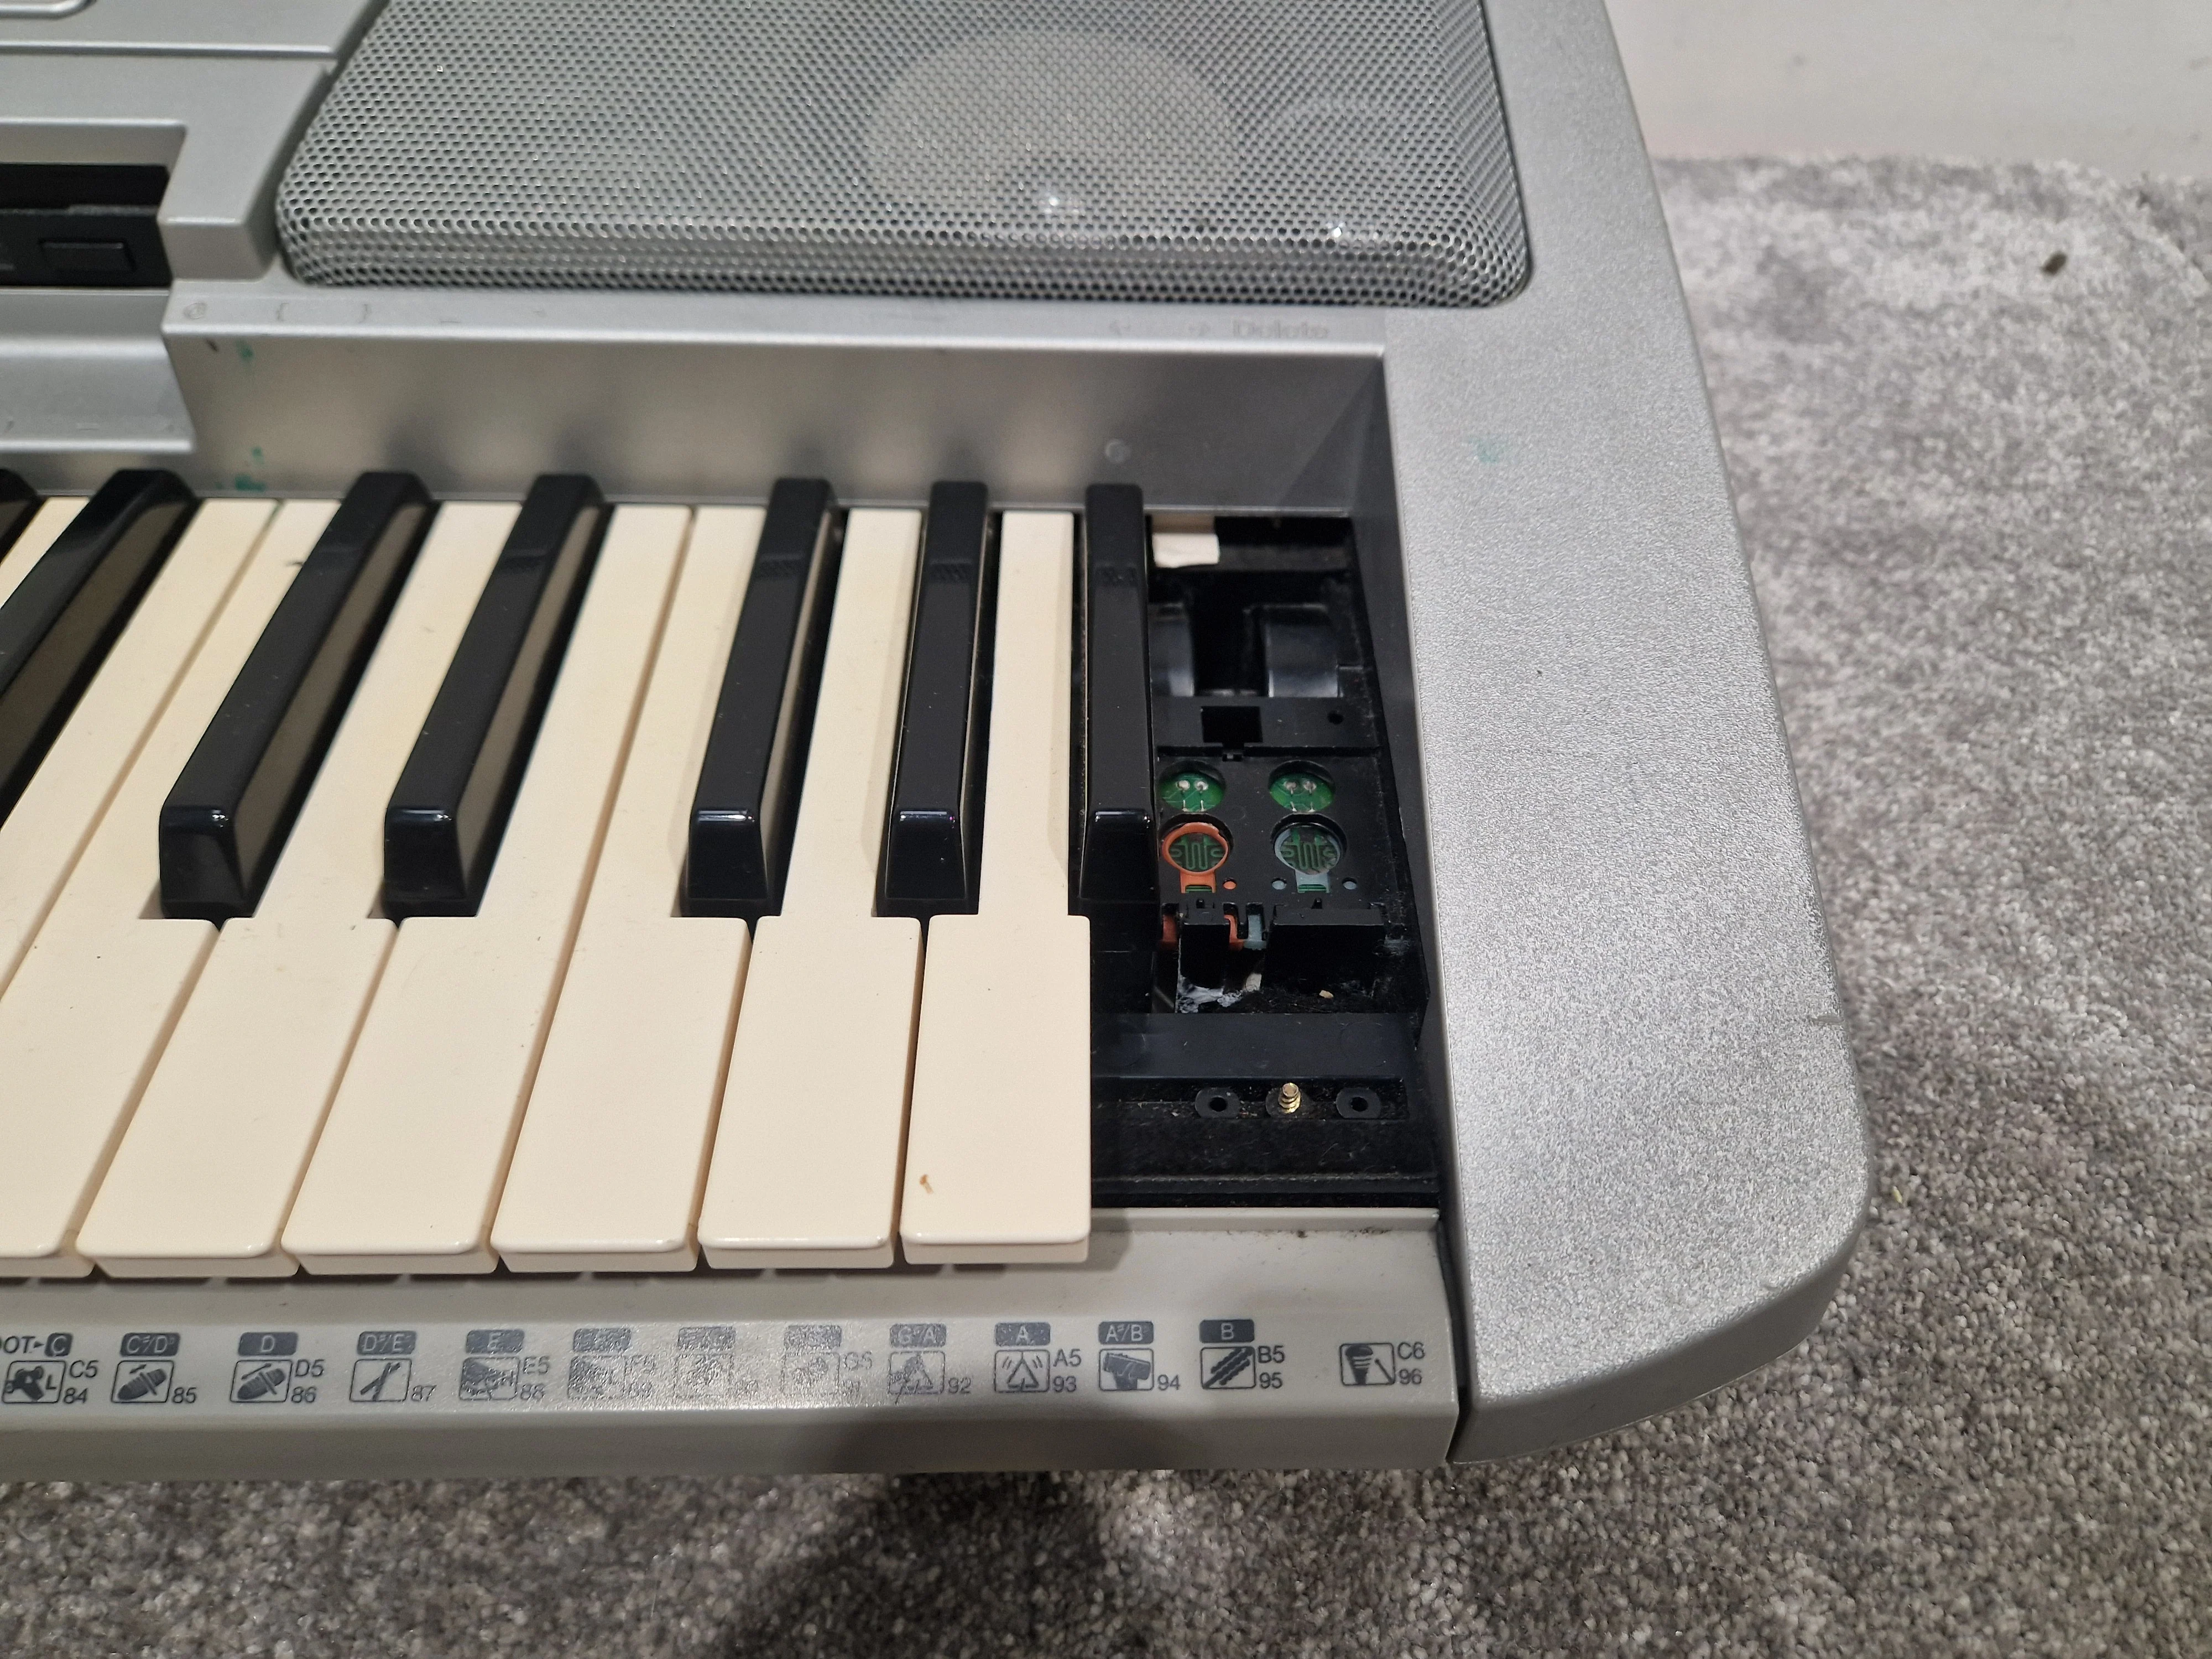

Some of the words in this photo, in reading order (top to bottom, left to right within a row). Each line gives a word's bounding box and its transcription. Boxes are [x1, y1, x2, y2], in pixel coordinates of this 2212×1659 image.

[1015, 1326, 1029, 1345] A
[1220, 1323, 1234, 1340] B
[0, 1335, 35, 1354] OT
[51, 1335, 67, 1354] C
[260, 1335, 275, 1353] D
[1397, 1342, 1426, 1360] C6
[1052, 1348, 1082, 1368] A5
[1258, 1345, 1286, 1364] B5
[69, 1360, 99, 1378] C5
[295, 1359, 325, 1378] D5
[523, 1355, 551, 1375] E5
[948, 1377, 972, 1394] 92
[1053, 1375, 1077, 1392] 93
[1157, 1374, 1181, 1391] 94
[1259, 1372, 1284, 1389] 95
[1398, 1368, 1423, 1385] 96
[63, 1387, 88, 1404] 84
[172, 1386, 197, 1404] 85
[291, 1386, 317, 1404] 86
[411, 1384, 437, 1402] 87
